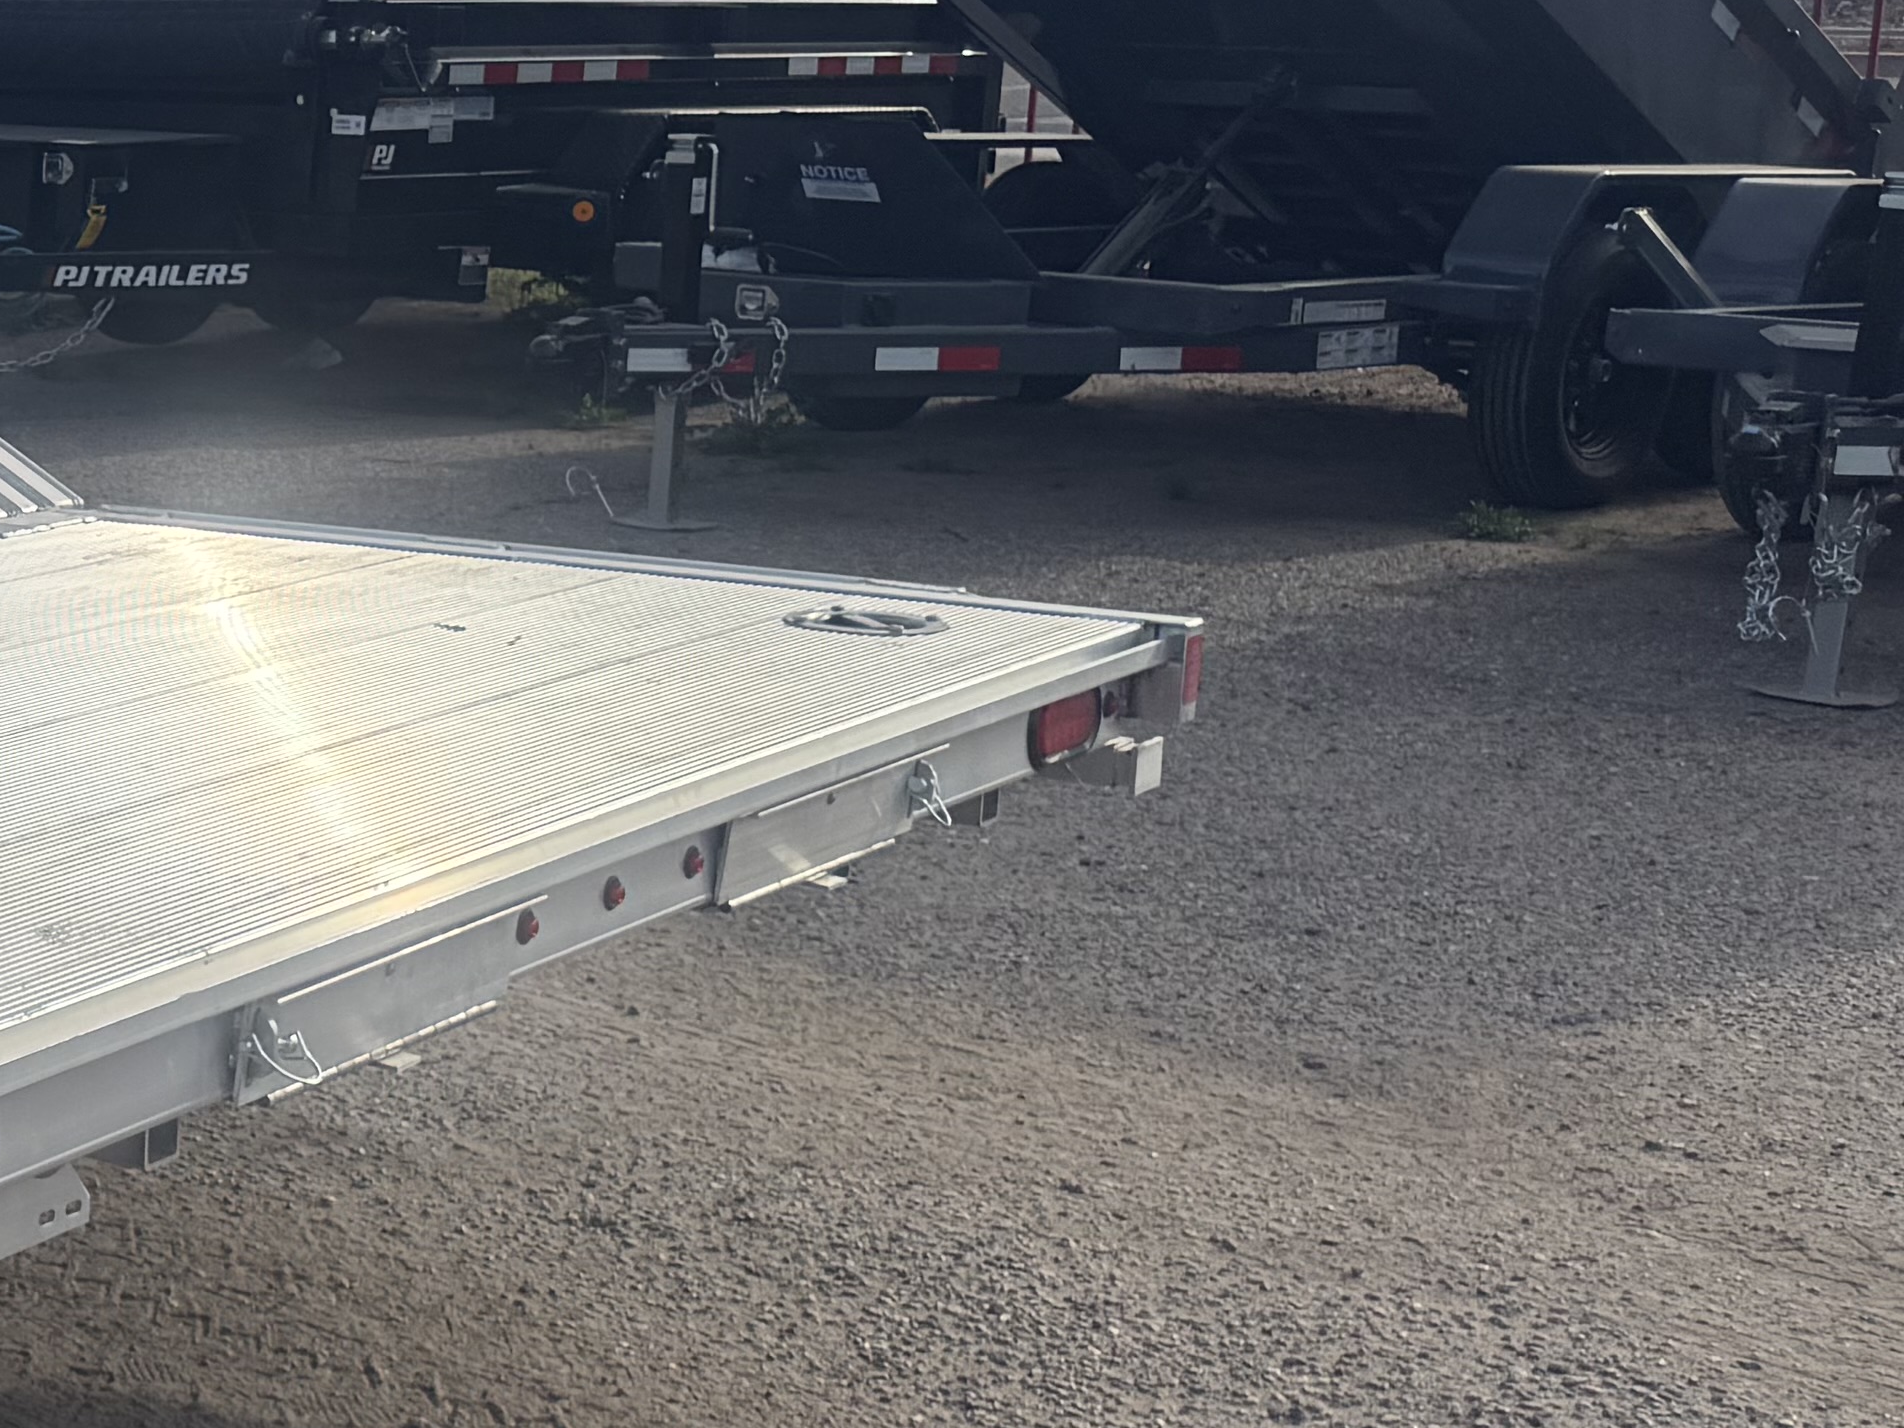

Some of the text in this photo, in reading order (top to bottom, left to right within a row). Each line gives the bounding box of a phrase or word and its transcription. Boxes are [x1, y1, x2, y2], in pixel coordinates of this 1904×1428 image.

[371, 144, 396, 165] PJ
[800, 164, 870, 181] NOTICE
[93, 263, 250, 287] TRAILERS
